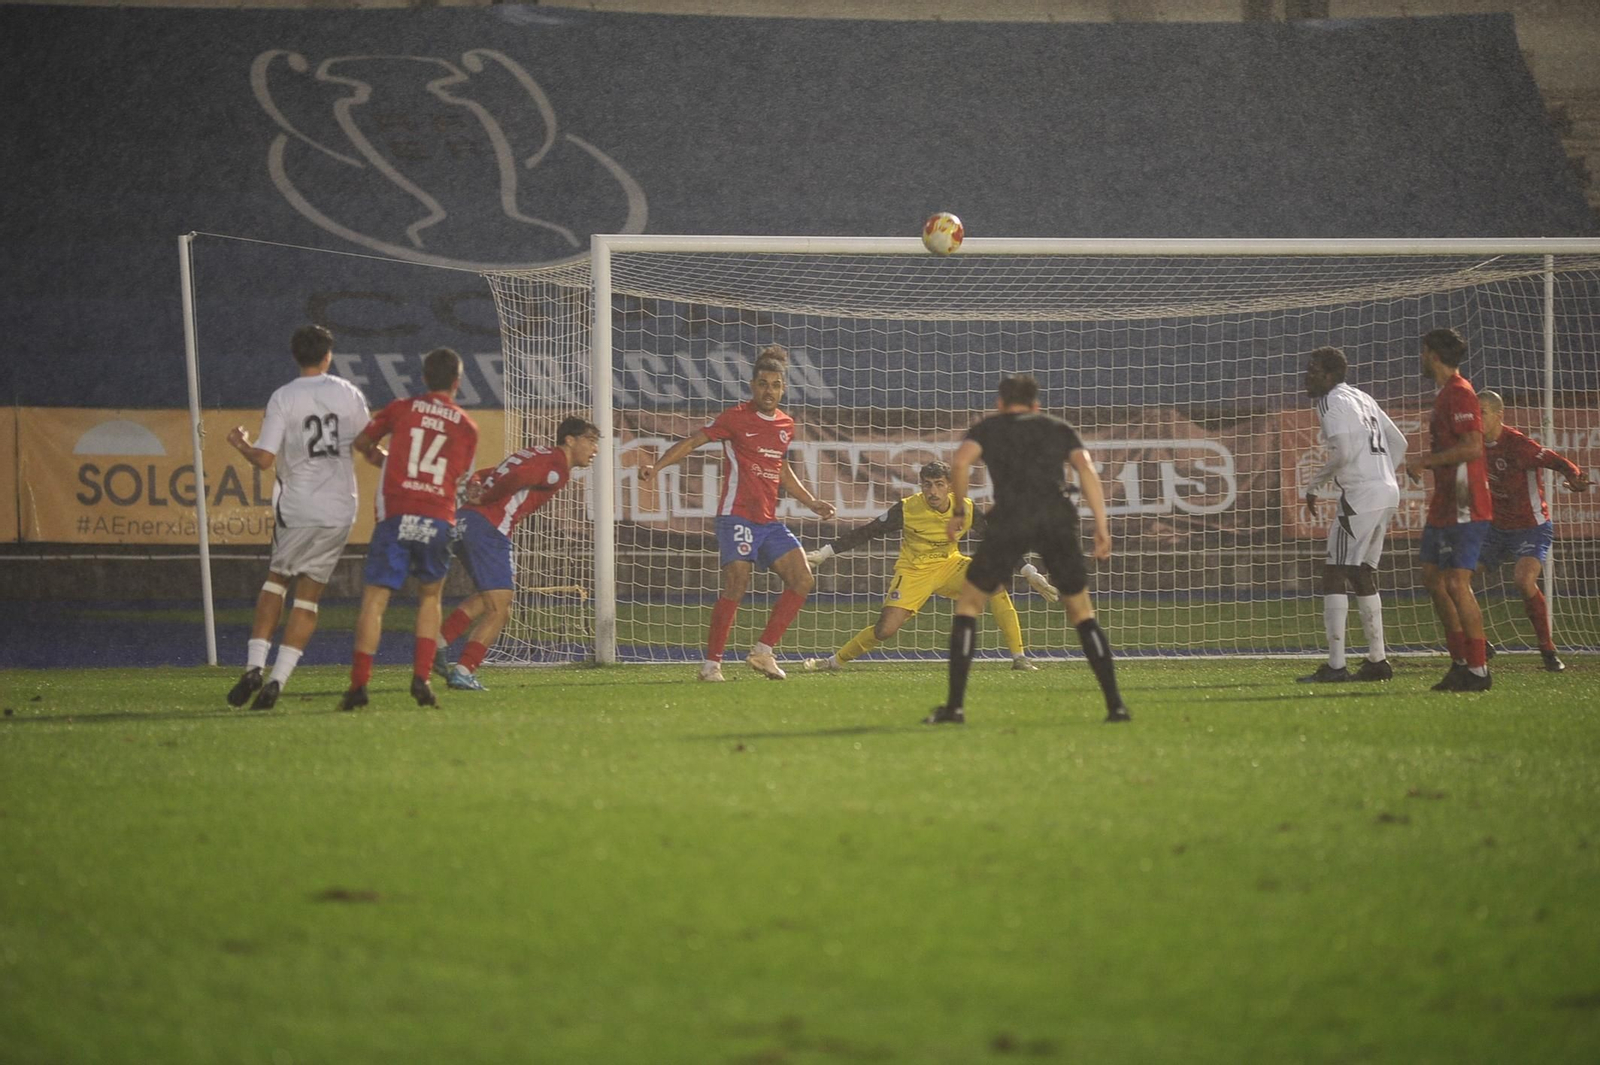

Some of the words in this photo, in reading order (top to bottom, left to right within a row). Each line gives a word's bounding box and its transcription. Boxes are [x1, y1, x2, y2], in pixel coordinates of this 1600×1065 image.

[303, 413, 339, 458] 23
[407, 427, 446, 485] 14
[734, 525, 753, 543] 20
